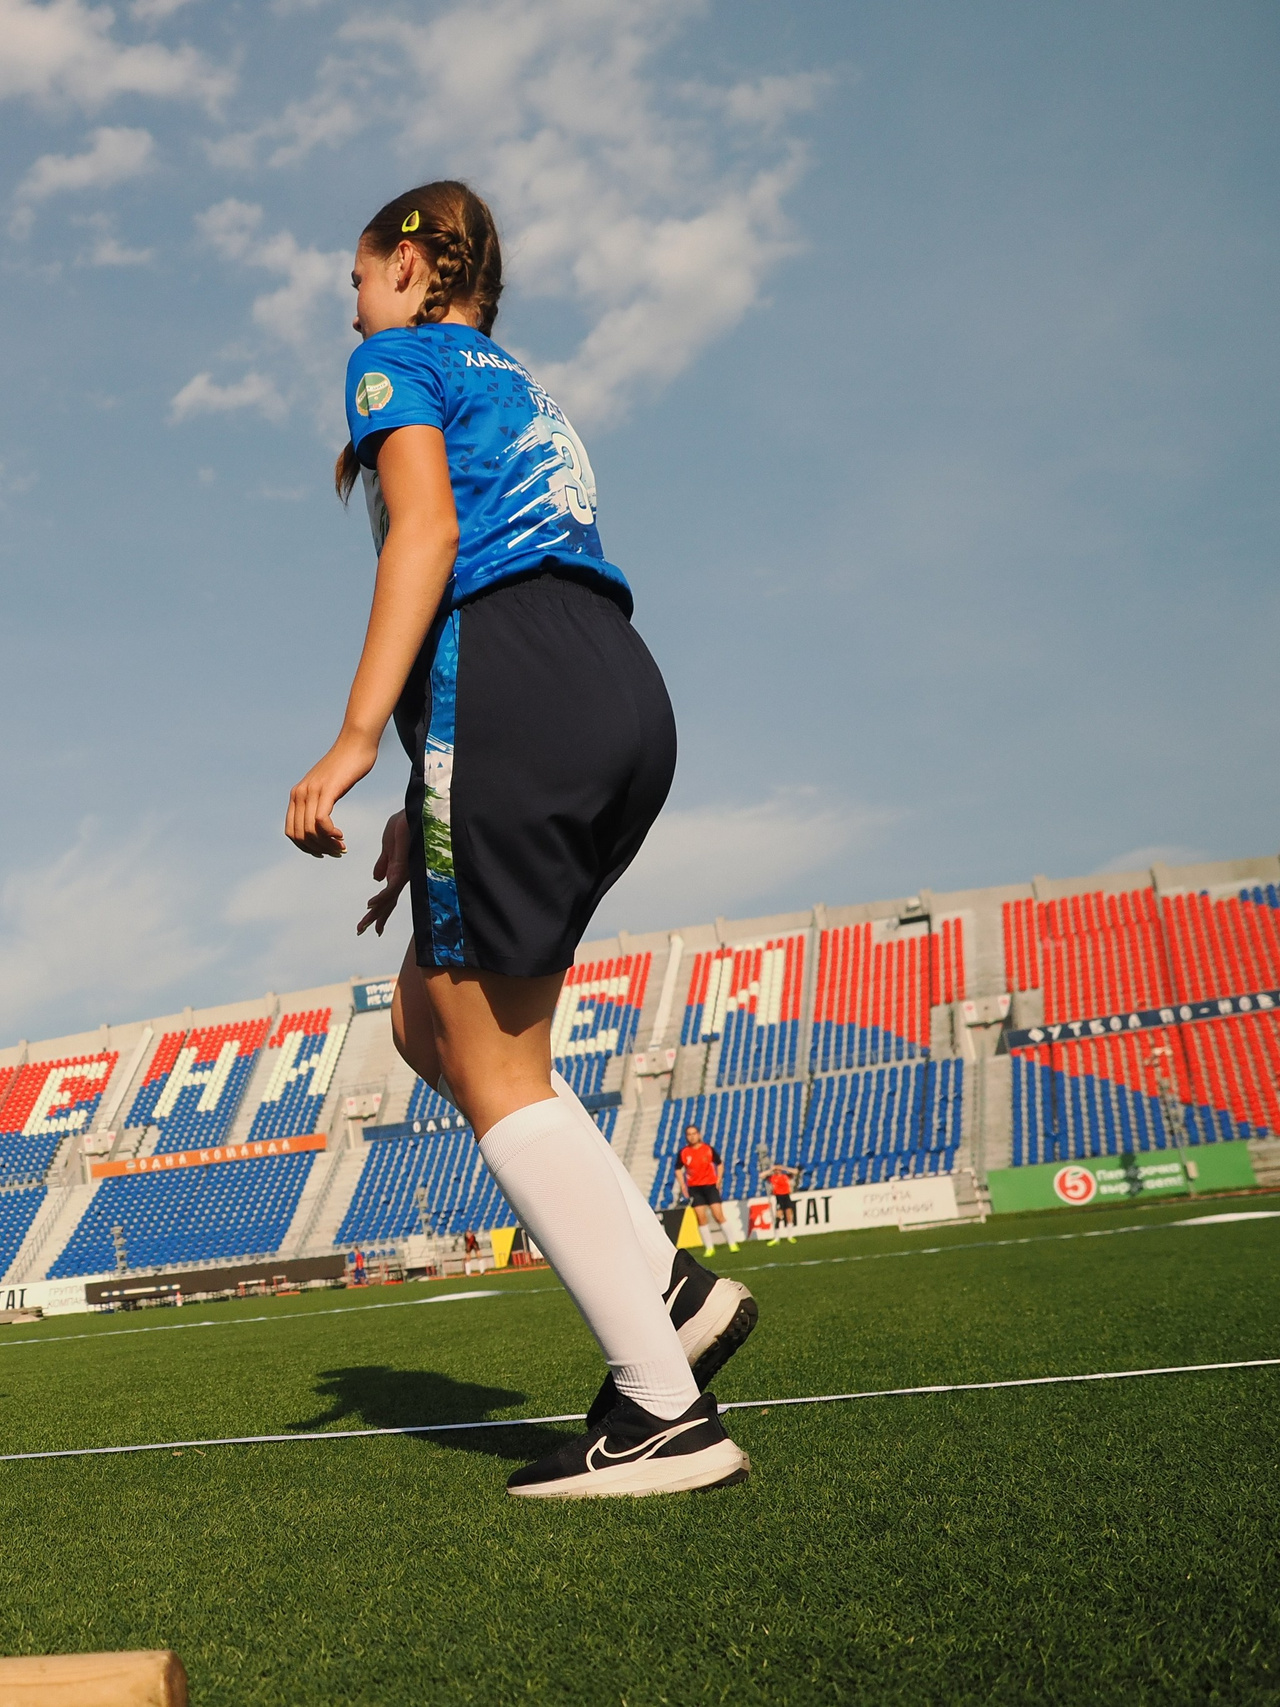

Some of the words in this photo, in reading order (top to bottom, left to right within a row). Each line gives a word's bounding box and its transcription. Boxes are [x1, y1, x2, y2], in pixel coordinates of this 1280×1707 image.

[551, 433, 594, 525] 3
[1028, 1013, 1142, 1042] ФУТБОЛ
[413, 1115, 466, 1133] ОДНА
[139, 1153, 187, 1171] ОДНА
[200, 1138, 291, 1162] КОМАНДА
[1061, 1169, 1088, 1199] 5
